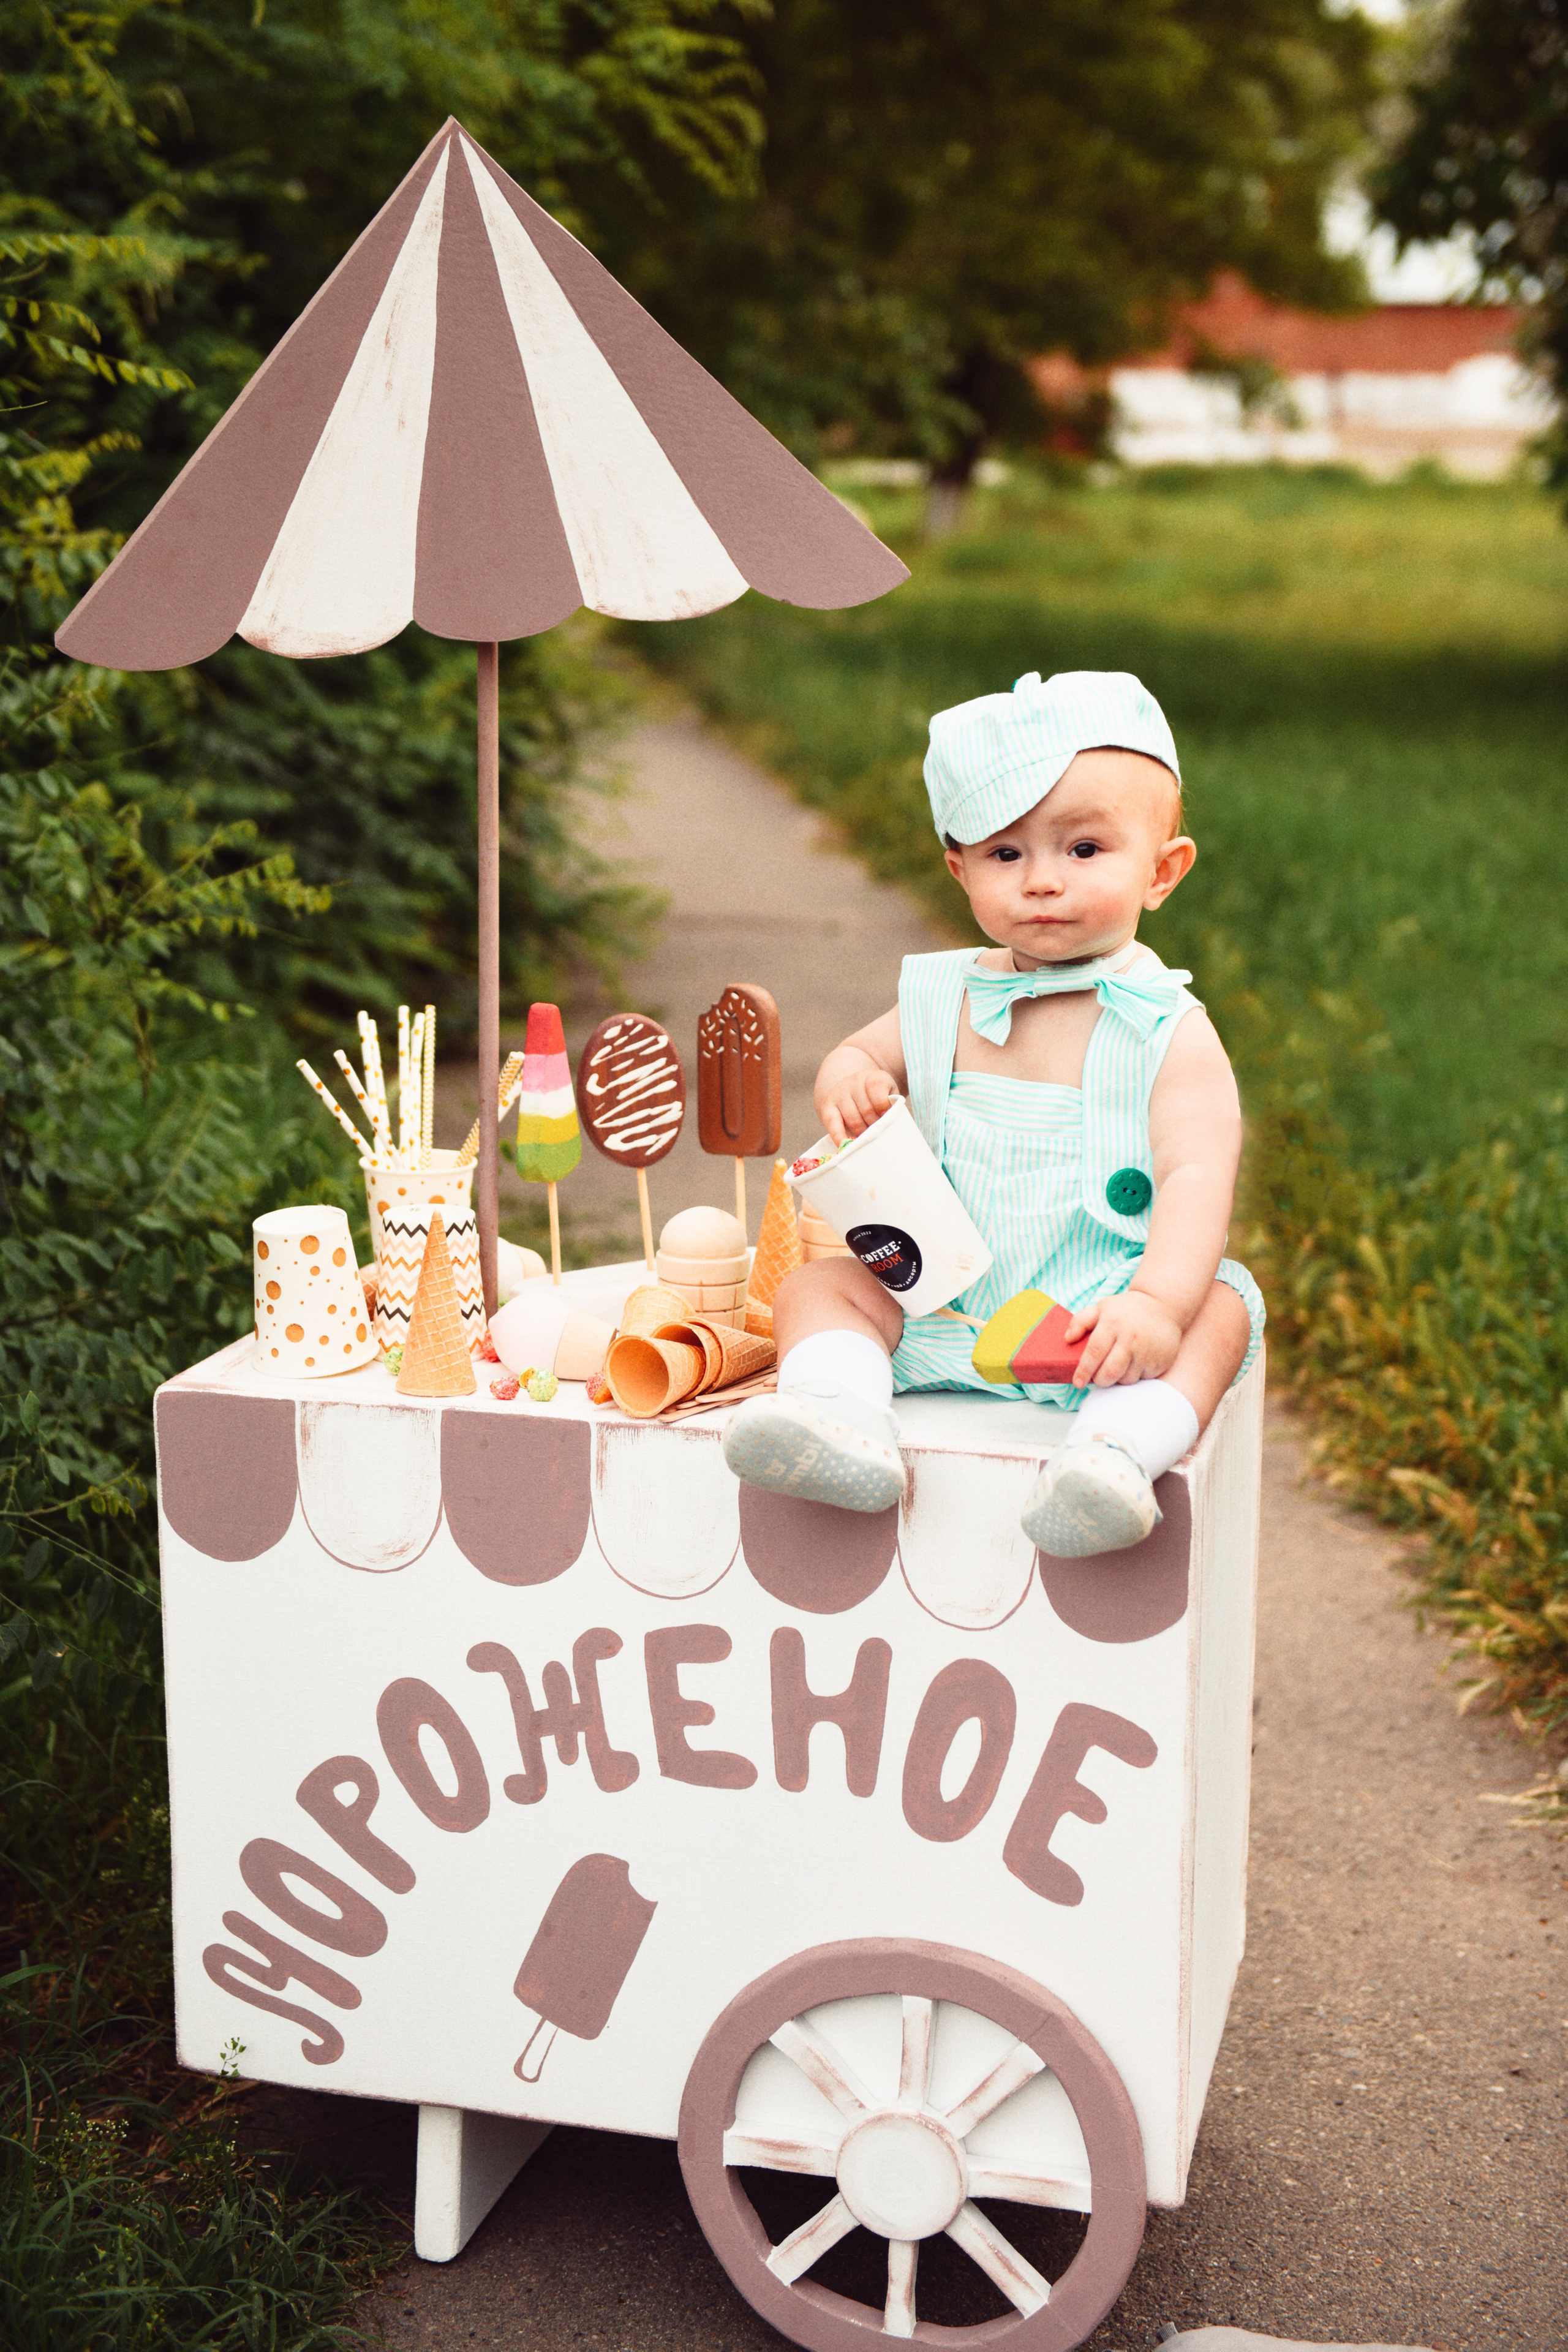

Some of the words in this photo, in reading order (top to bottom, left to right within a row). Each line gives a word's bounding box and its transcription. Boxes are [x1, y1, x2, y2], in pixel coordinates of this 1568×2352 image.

[860, 1240, 900, 1264] COFFEE
[870, 1253, 904, 1273] ROOM
[203, 1624, 1158, 2065] МОРОЖЕНОЕ
